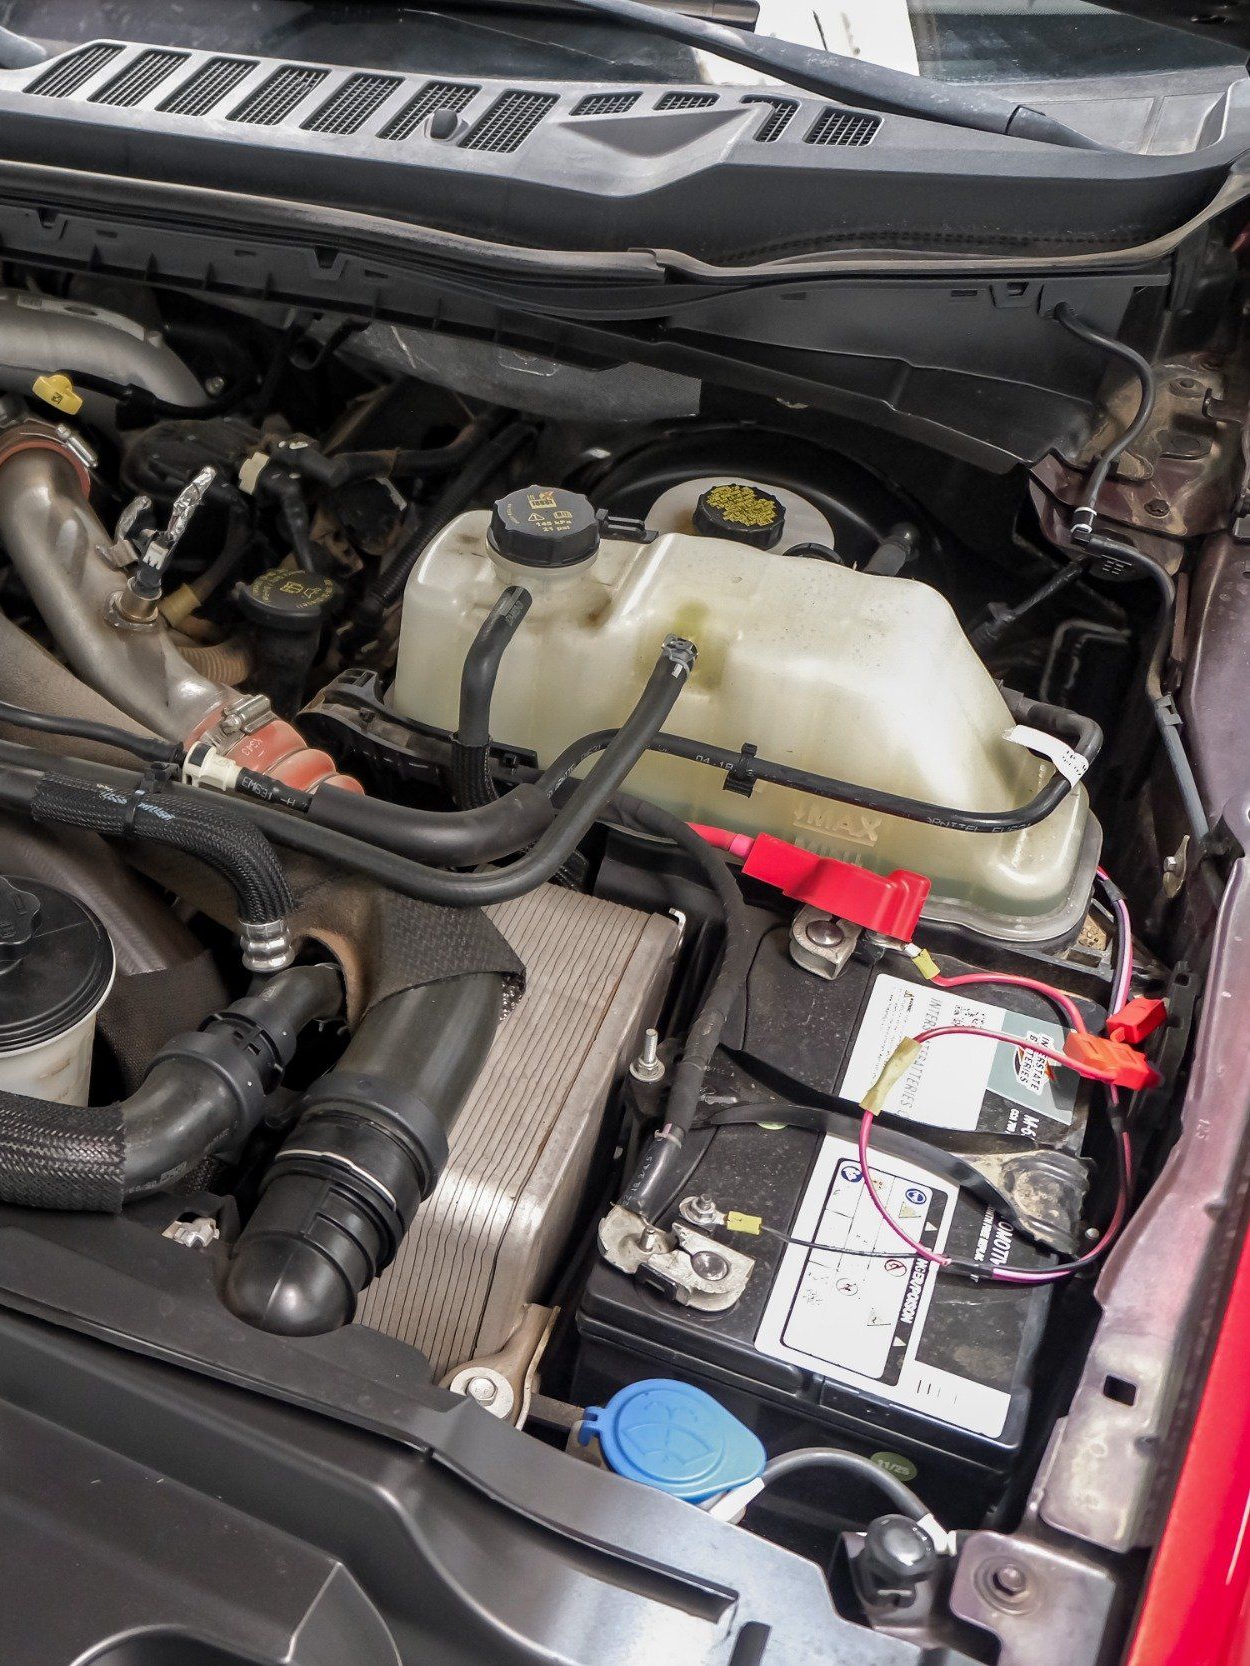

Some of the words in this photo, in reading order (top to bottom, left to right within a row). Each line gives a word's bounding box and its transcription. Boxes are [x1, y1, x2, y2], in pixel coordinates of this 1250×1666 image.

[807, 802, 883, 842] MAX
[1020, 1034, 1037, 1084] BTERIES
[1031, 1035, 1049, 1092] INERSTATE
[1020, 1113, 1040, 1140] M-6
[900, 1250, 929, 1323] NGER/POISON
